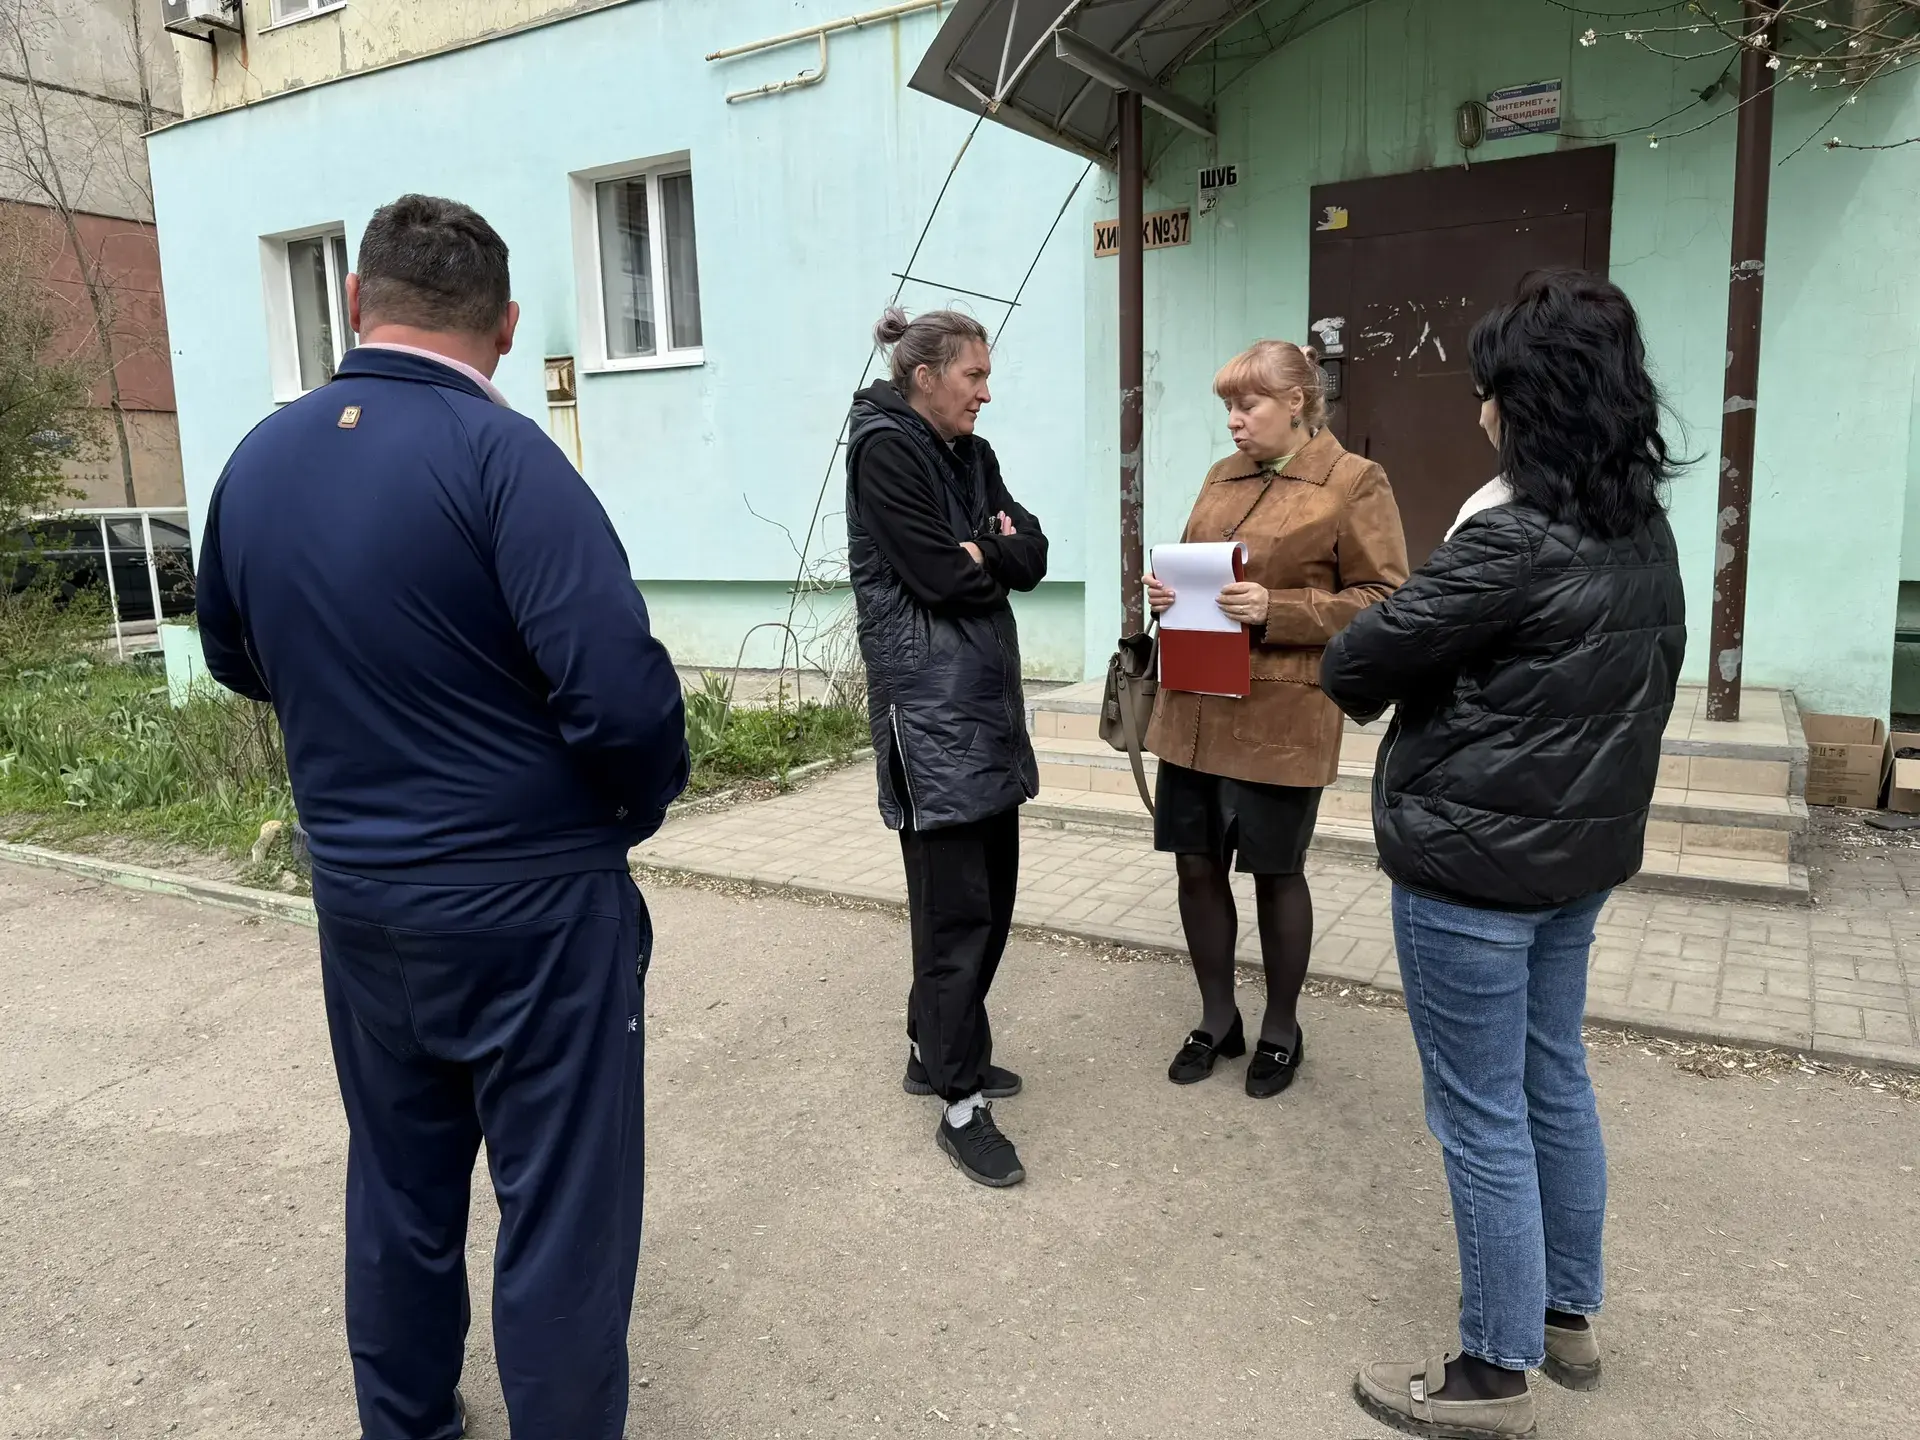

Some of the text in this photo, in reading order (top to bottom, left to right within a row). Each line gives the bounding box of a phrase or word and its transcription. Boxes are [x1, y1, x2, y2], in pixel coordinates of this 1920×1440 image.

[1490, 106, 1557, 123] ТЕЛЕВИДЕНИЕ
[1495, 98, 1543, 112] ИНТЕРНЕТ
[1200, 165, 1237, 189] ШУБ
[1096, 221, 1150, 251] ХИК
